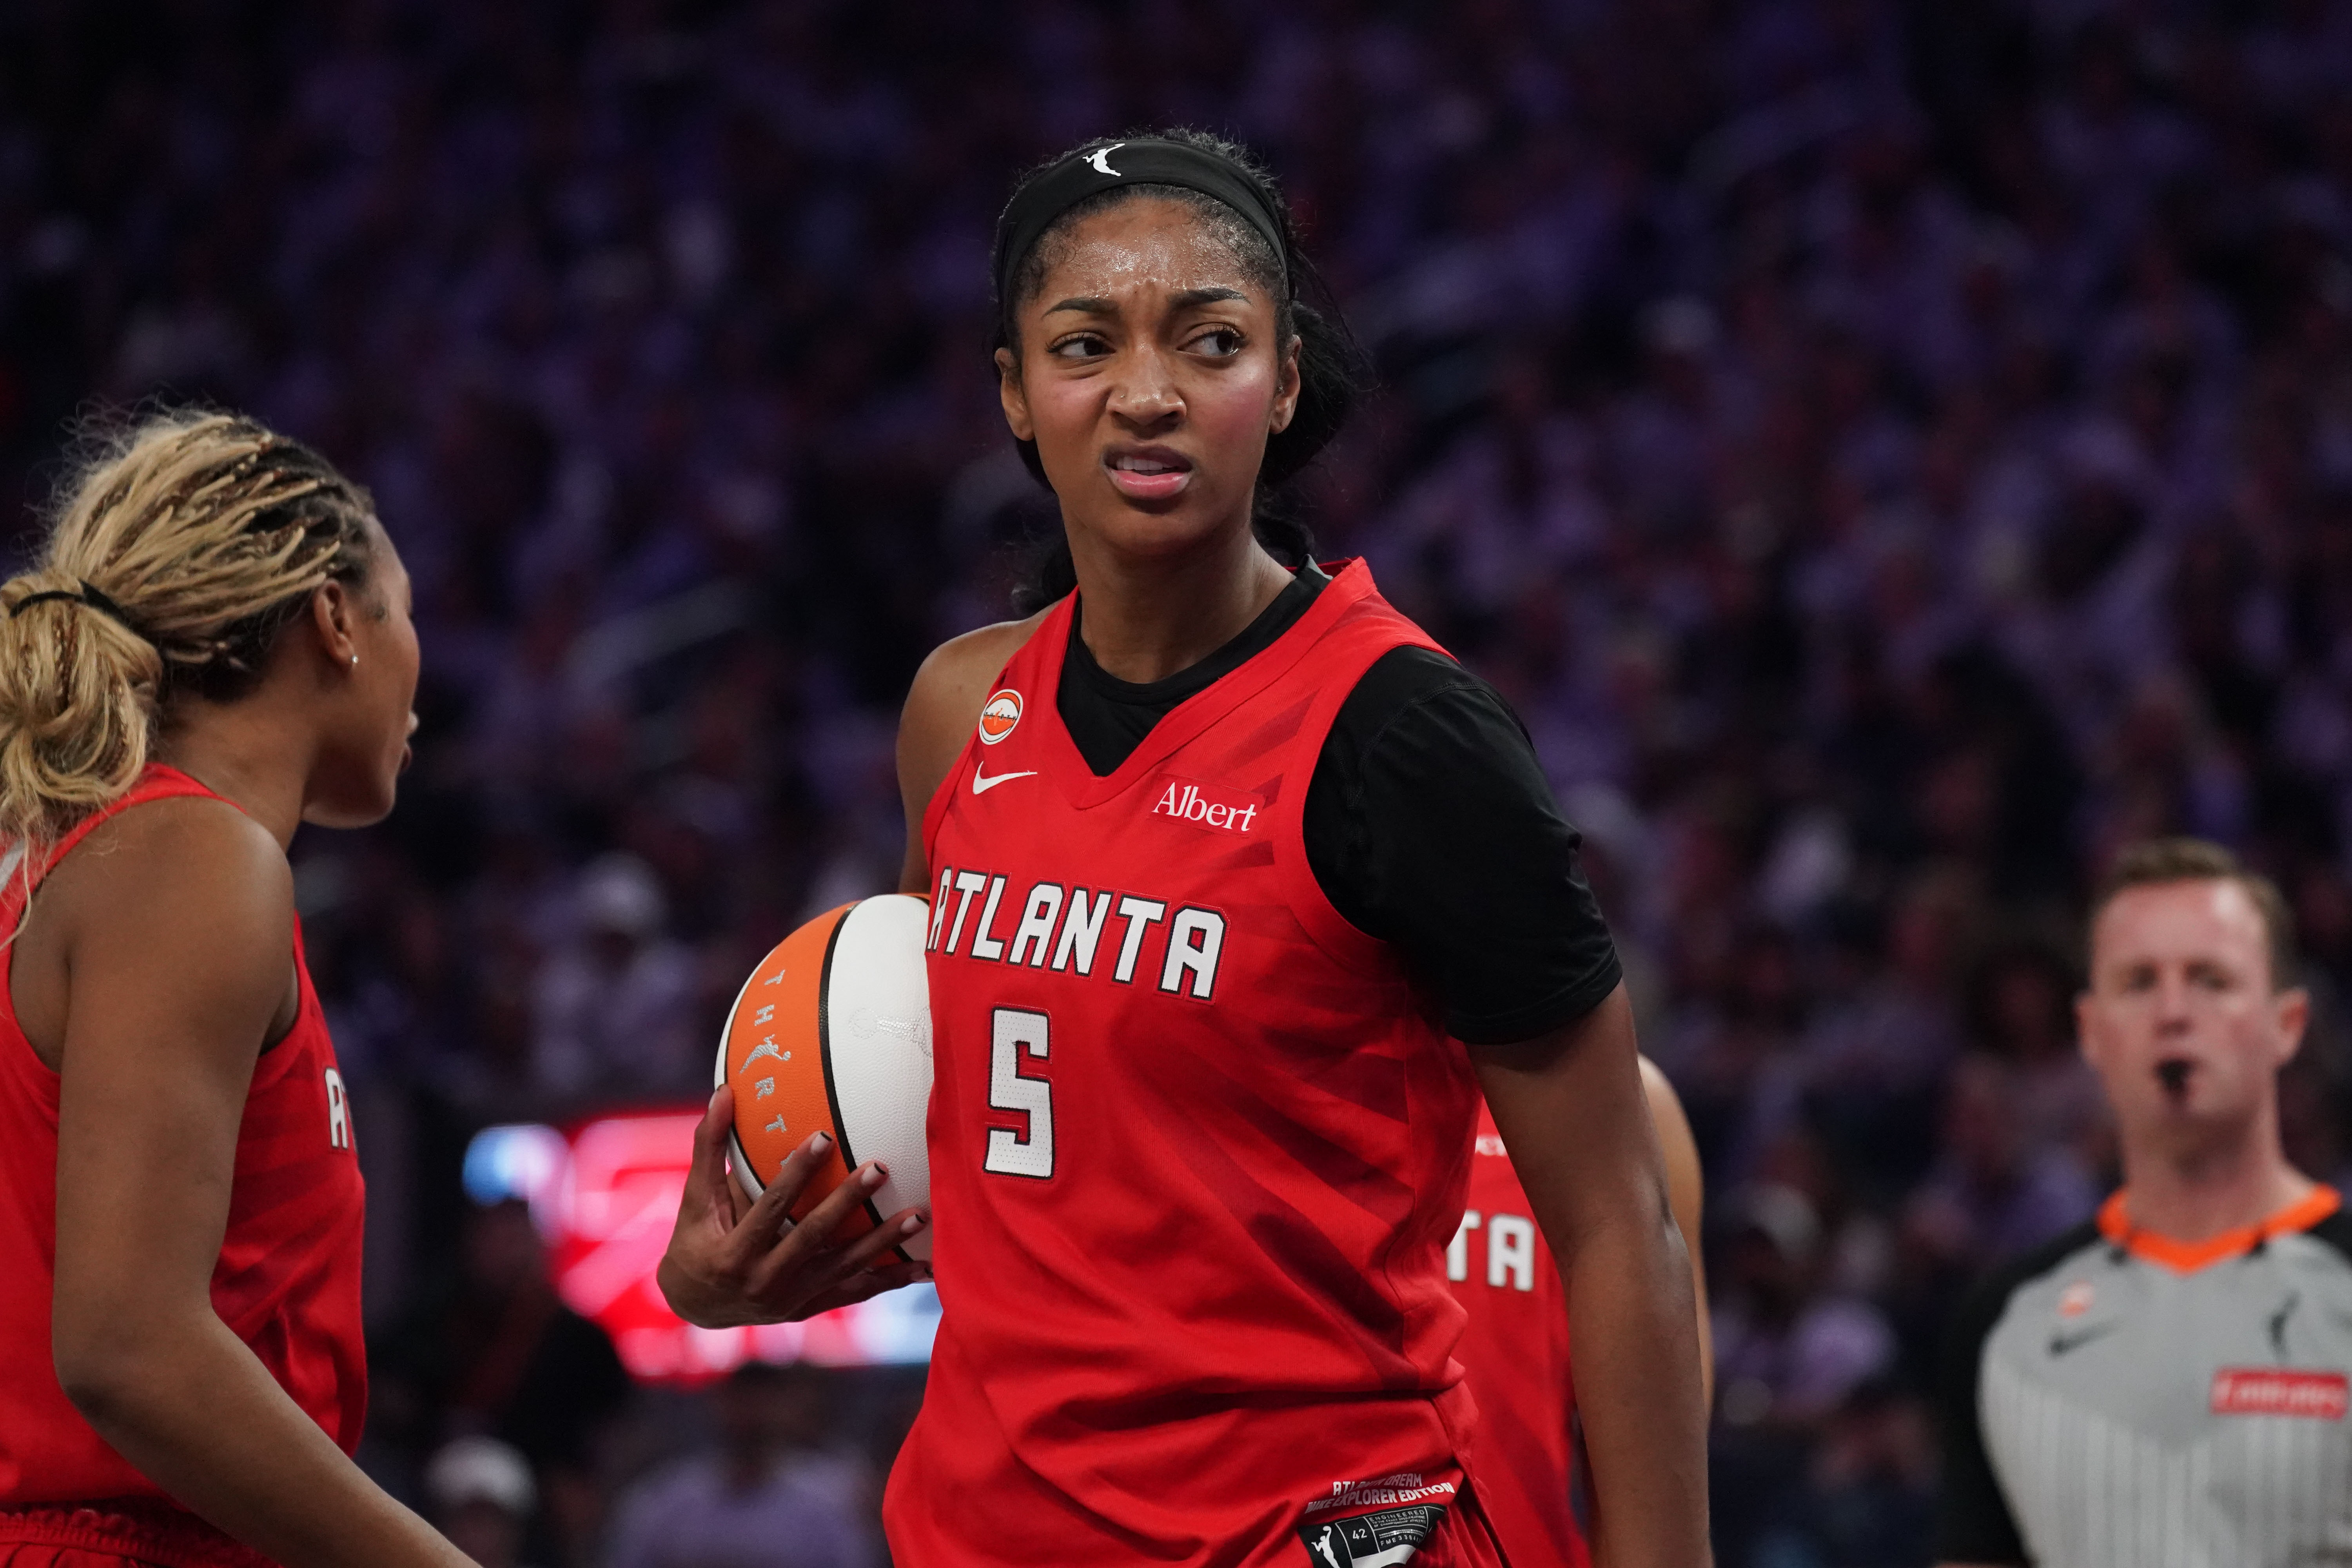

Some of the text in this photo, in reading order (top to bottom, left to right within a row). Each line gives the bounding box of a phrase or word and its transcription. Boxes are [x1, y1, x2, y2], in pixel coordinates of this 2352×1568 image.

[1152, 782, 1257, 831] Albert
[926, 867, 1227, 1000] ATLANTA
[983, 1007, 1056, 1180] 5
[1384, 1474, 1422, 1487] DREAM
[1305, 1482, 1455, 1514] NIKE EXPLORER EDITION
[1369, 1510, 1425, 1522] ENGINEERED
[1353, 1528, 1367, 1539] 42
